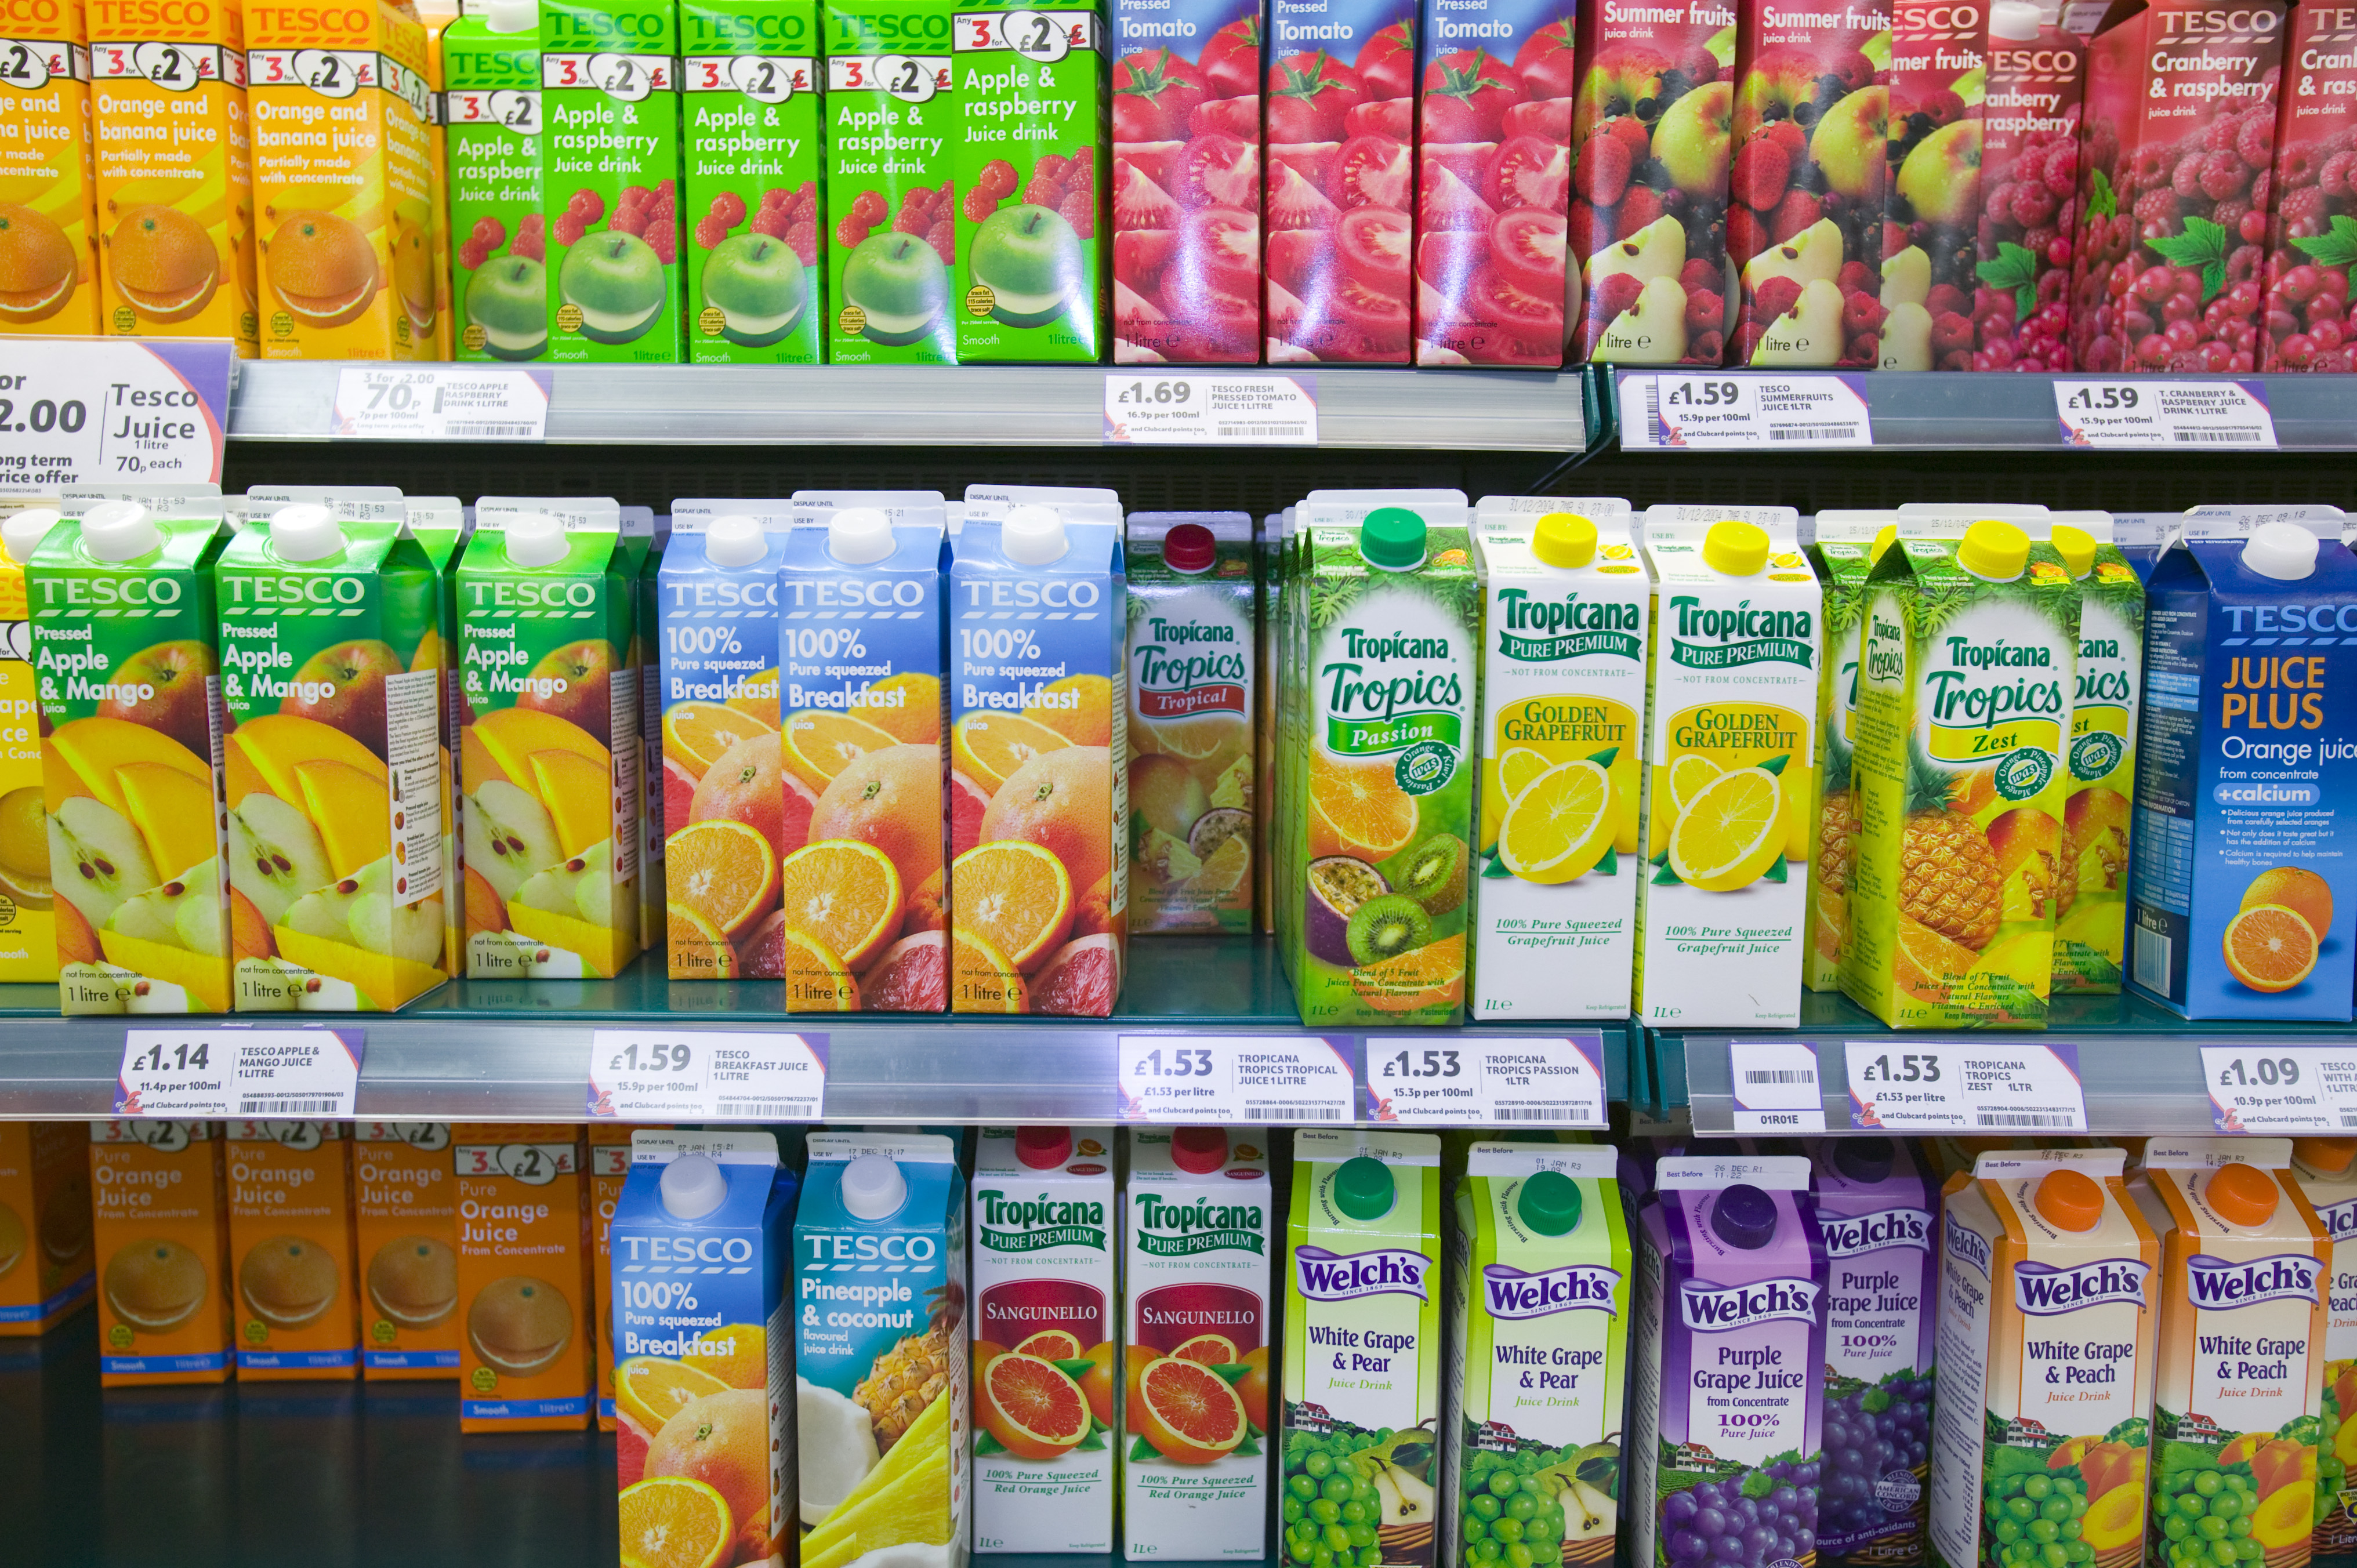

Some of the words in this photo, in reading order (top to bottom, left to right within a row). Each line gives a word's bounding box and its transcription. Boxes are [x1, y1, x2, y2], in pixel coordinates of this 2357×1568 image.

[252, 8, 370, 34] TESCO
[1119, 17, 1196, 38] Tomato
[1763, 6, 1841, 28] Summer
[1846, 5, 1891, 31] fruits
[2158, 9, 2277, 33] TESCO
[956, 16, 971, 25] Any
[971, 20, 991, 47] 3
[991, 38, 1003, 47] for
[1020, 17, 1050, 53] £2
[1121, 43, 1143, 56] juice
[2151, 49, 2258, 77] Cranberry
[963, 65, 1030, 94] Apple
[1039, 67, 1056, 88] &
[2149, 78, 2167, 98] &
[2174, 75, 2274, 103] raspberry
[256, 100, 325, 125] Orange
[330, 101, 368, 122] and
[963, 92, 1077, 121] raspberry
[2148, 107, 2171, 120] juice
[2173, 106, 2196, 117] drink
[258, 126, 328, 146] banana
[331, 126, 376, 151] juice
[111, 384, 198, 407] Tesco
[1118, 382, 1191, 404] £1.69
[1669, 382, 1739, 405] £1.59
[1761, 393, 1833, 402] SUMMERFRUITS
[2068, 387, 2138, 409] £1.59
[114, 416, 195, 439] Juice
[117, 456, 146, 473] 70p
[150, 458, 182, 469] each
[222, 576, 365, 604] TESCO
[1497, 588, 1640, 634] Tropicana
[223, 622, 278, 639] Pressed
[1149, 618, 1234, 647] Tropicana
[786, 629, 866, 659] 100%
[223, 642, 293, 674] Apple
[789, 662, 821, 676] Pure
[824, 660, 891, 679] squeezed
[1135, 645, 1246, 693] Tropics
[1512, 668, 1529, 676] NOT
[1533, 668, 1559, 677] FROM
[1562, 668, 1627, 677] CONCENTRATE
[2222, 656, 2325, 689] JUICE
[226, 673, 244, 697] &
[251, 674, 336, 705] Mango
[789, 681, 907, 709] Breakfast
[1157, 688, 1227, 710] Tropical
[1322, 662, 1463, 722] Tropics
[1926, 670, 2062, 729] Tropics
[2222, 693, 2323, 729] PLUS
[1351, 724, 1434, 747] Passion
[1972, 732, 2018, 753] Zest
[1412, 757, 1438, 778] was
[2286, 810, 2302, 818] juice
[2304, 810, 2334, 818] produced
[1496, 919, 1527, 930] 100%
[1532, 919, 1561, 929] Pure
[1565, 919, 1622, 932] Squeezed
[1508, 935, 1575, 948] Grapefruit
[1578, 935, 1609, 947] Juice
[241, 966, 252, 974] not
[253, 965, 270, 974] from
[272, 967, 315, 975] concentrate
[1943, 972, 1966, 981] Blend
[1970, 972, 1978, 981] of
[1989, 972, 2010, 981] Fruit
[242, 982, 248, 997] 1
[253, 981, 282, 998] litre
[132, 1043, 209, 1071] £1.14
[241, 1047, 275, 1055] TESCO
[609, 1044, 691, 1071] £1.59
[715, 1061, 776, 1070] BREAKFAST
[778, 1062, 808, 1071] JUICE
[1134, 1050, 1213, 1076] £1.53
[1383, 1051, 1461, 1077] £1.53
[1486, 1066, 1531, 1075] TROPICS
[1533, 1066, 1579, 1075] PASSION
[1864, 1055, 1940, 1082] £1.53
[2220, 1058, 2299, 1086] £1.09
[1144, 1087, 1172, 1096] £1.53
[1174, 1088, 1191, 1097] per
[1194, 1087, 1214, 1096] litre
[2234, 1097, 2262, 1106] 10.9p
[2265, 1098, 2282, 1106] per
[2284, 1096, 2316, 1105] 100ml
[1761, 1115, 1798, 1124] 01R01E
[460, 1199, 549, 1223] Orange
[461, 1224, 518, 1243] Juice
[462, 1245, 491, 1255] From
[495, 1244, 565, 1255] Concentrate
[621, 1237, 752, 1263] TESCO
[1300, 1255, 1420, 1291] Welch's
[2192, 1262, 2311, 1300] Welch's
[802, 1278, 912, 1308] Pineapple
[1366, 1284, 1383, 1293] 1869
[1685, 1284, 1810, 1324] Welch's
[803, 1304, 821, 1327] &
[826, 1308, 913, 1329] coconut
[803, 1330, 848, 1343] flavoured
[1309, 1326, 1358, 1348] White
[1364, 1330, 1415, 1353] Grape
[2200, 1337, 2251, 1355] White
[2256, 1338, 2305, 1358] Grape
[1333, 1353, 1346, 1370] &
[1352, 1353, 1391, 1372] Pear
[1718, 1346, 1782, 1370] Purple
[1694, 1370, 1751, 1393] Grape
[1755, 1370, 1803, 1389] Juice
[2217, 1362, 2231, 1378] &
[2238, 1361, 2287, 1380] Peach
[1328, 1377, 1355, 1390] Juice
[1359, 1379, 1393, 1391] Drink
[1707, 1396, 1729, 1407] from
[1732, 1396, 1789, 1407] Concentrate
[1717, 1414, 1780, 1427] 100%
[1816, 1538, 1842, 1546] ource
[1845, 1534, 1855, 1543] of
[1858, 1520, 1916, 1540] anti-oxidants
